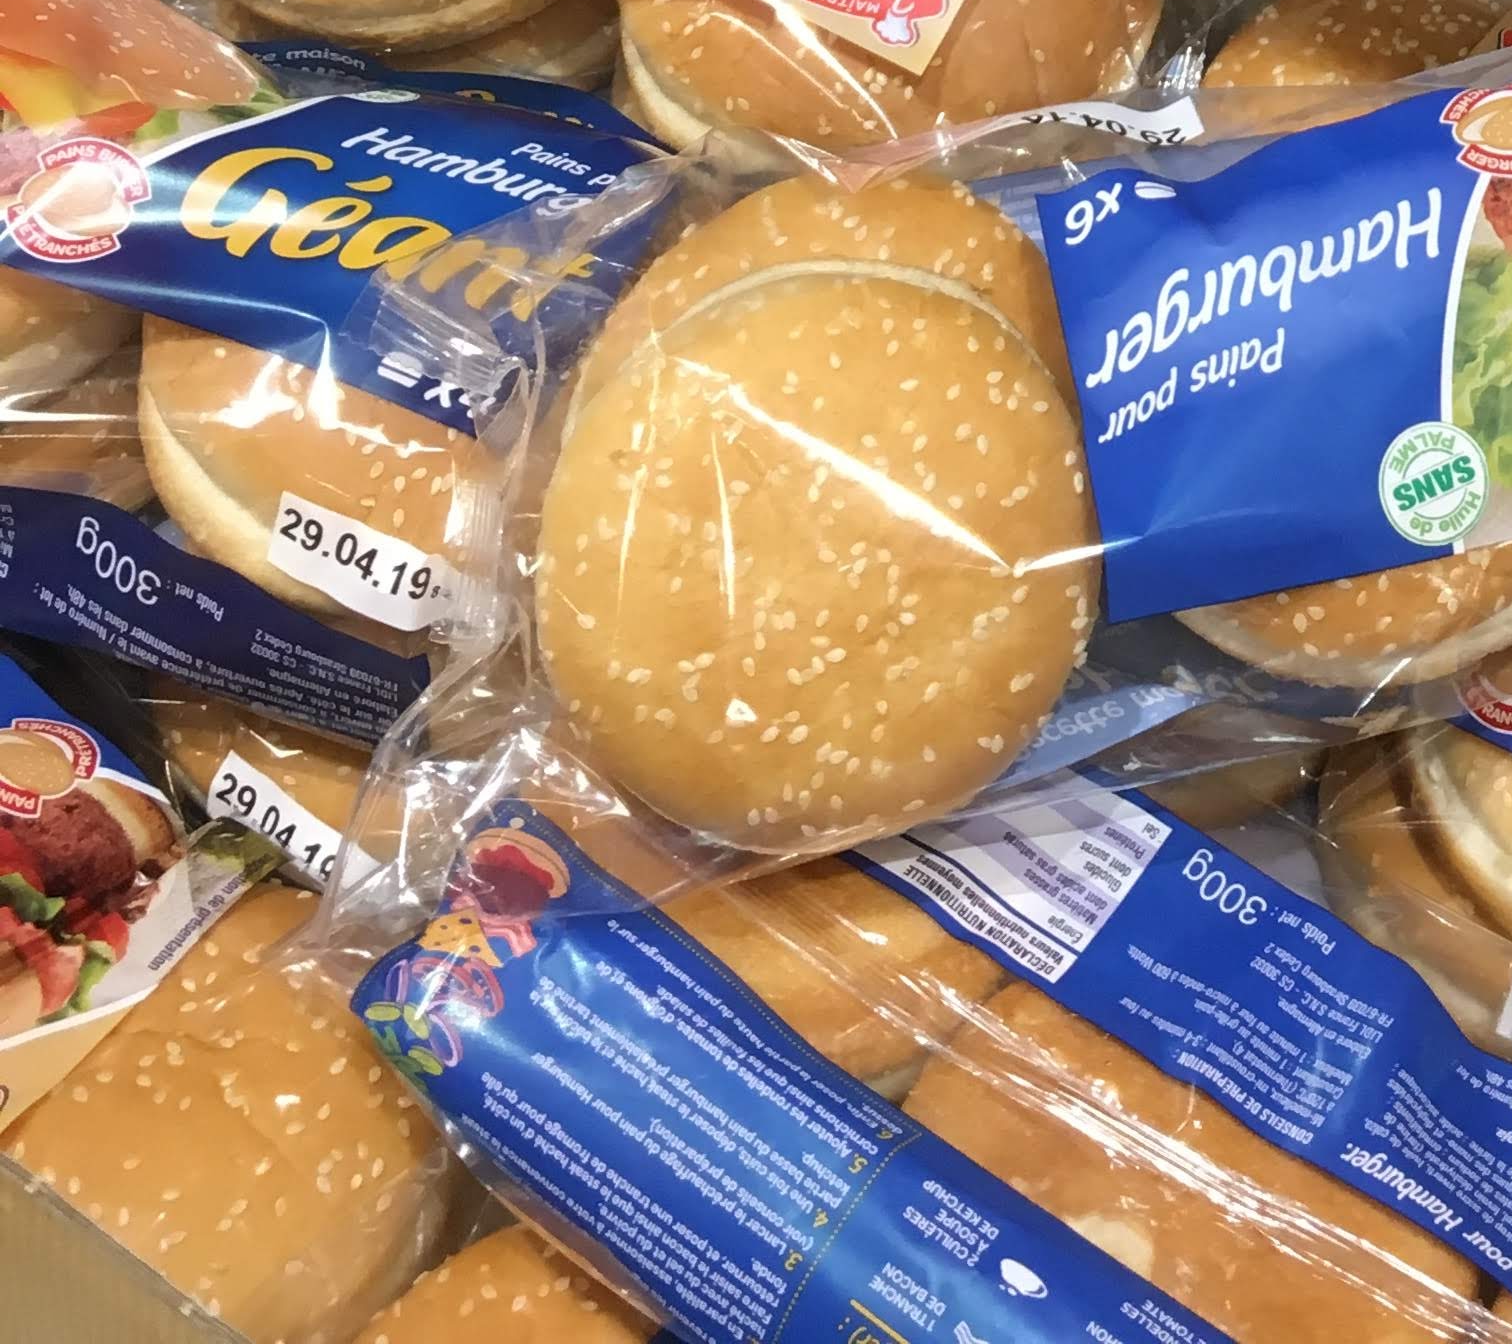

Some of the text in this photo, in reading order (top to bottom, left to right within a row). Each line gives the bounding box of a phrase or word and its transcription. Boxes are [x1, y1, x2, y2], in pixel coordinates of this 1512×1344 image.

[285, 47, 365, 71] maison
[45, 145, 97, 165] PAINS
[340, 127, 593, 221] Hamburg
[511, 144, 592, 182] Pains
[179, 147, 597, 324] Géant
[1063, 180, 1124, 246] x6
[1084, 186, 1444, 387] Hamburger
[1098, 328, 1288, 447] Pains pour
[1381, 430, 1456, 473] PALME
[1392, 455, 1475, 511] SANS
[1408, 490, 1487, 538] Huile de
[75, 516, 164, 605] 300g
[277, 506, 433, 604] 29.04.19
[36, 585, 56, 605] lot
[51, 595, 69, 614] de
[172, 580, 196, 601] net
[195, 592, 224, 621] Poids
[67, 606, 107, 640] Numéro
[1101, 822, 1146, 861] Protéines
[1141, 824, 1159, 840] Sel
[1078, 837, 1133, 879] dont sucres
[1080, 857, 1123, 894] Glucides
[914, 852, 1065, 967] Valeurs nutritionnelles moyennes
[1021, 865, 1096, 926] Matières grasses
[1081, 889, 1107, 914] dont
[1181, 848, 1267, 925] 300g
[147, 891, 226, 981] de présentation
[902, 862, 1055, 975] DÉCLARATION NUTRITIONNELLE
[1044, 911, 1084, 946] Énergie
[1276, 907, 1301, 931] net
[1296, 919, 1338, 956] Poids
[1174, 1048, 1250, 1104] PRÉPARATION
[1242, 1094, 1264, 1114] DE
[1259, 1104, 1314, 1146] CONSEILS
[526, 1047, 803, 1271] 3. Lancer le préchauffage du pain pour Hamburger
[648, 1117, 816, 1252] (voir conseils de préparation).
[919, 1175, 1001, 1240] DE KETCHUP
[1341, 1144, 1463, 1238] Hamburger.
[902, 1205, 980, 1267] 2 CUILLÈRES
[933, 1206, 980, 1246] SOUPE
[865, 1272, 938, 1331] 1 TRANCHE
[879, 1260, 948, 1316] DE BACON
[1118, 1299, 1180, 1344] NDELLES
[1140, 1297, 1197, 1342] TOMATE
